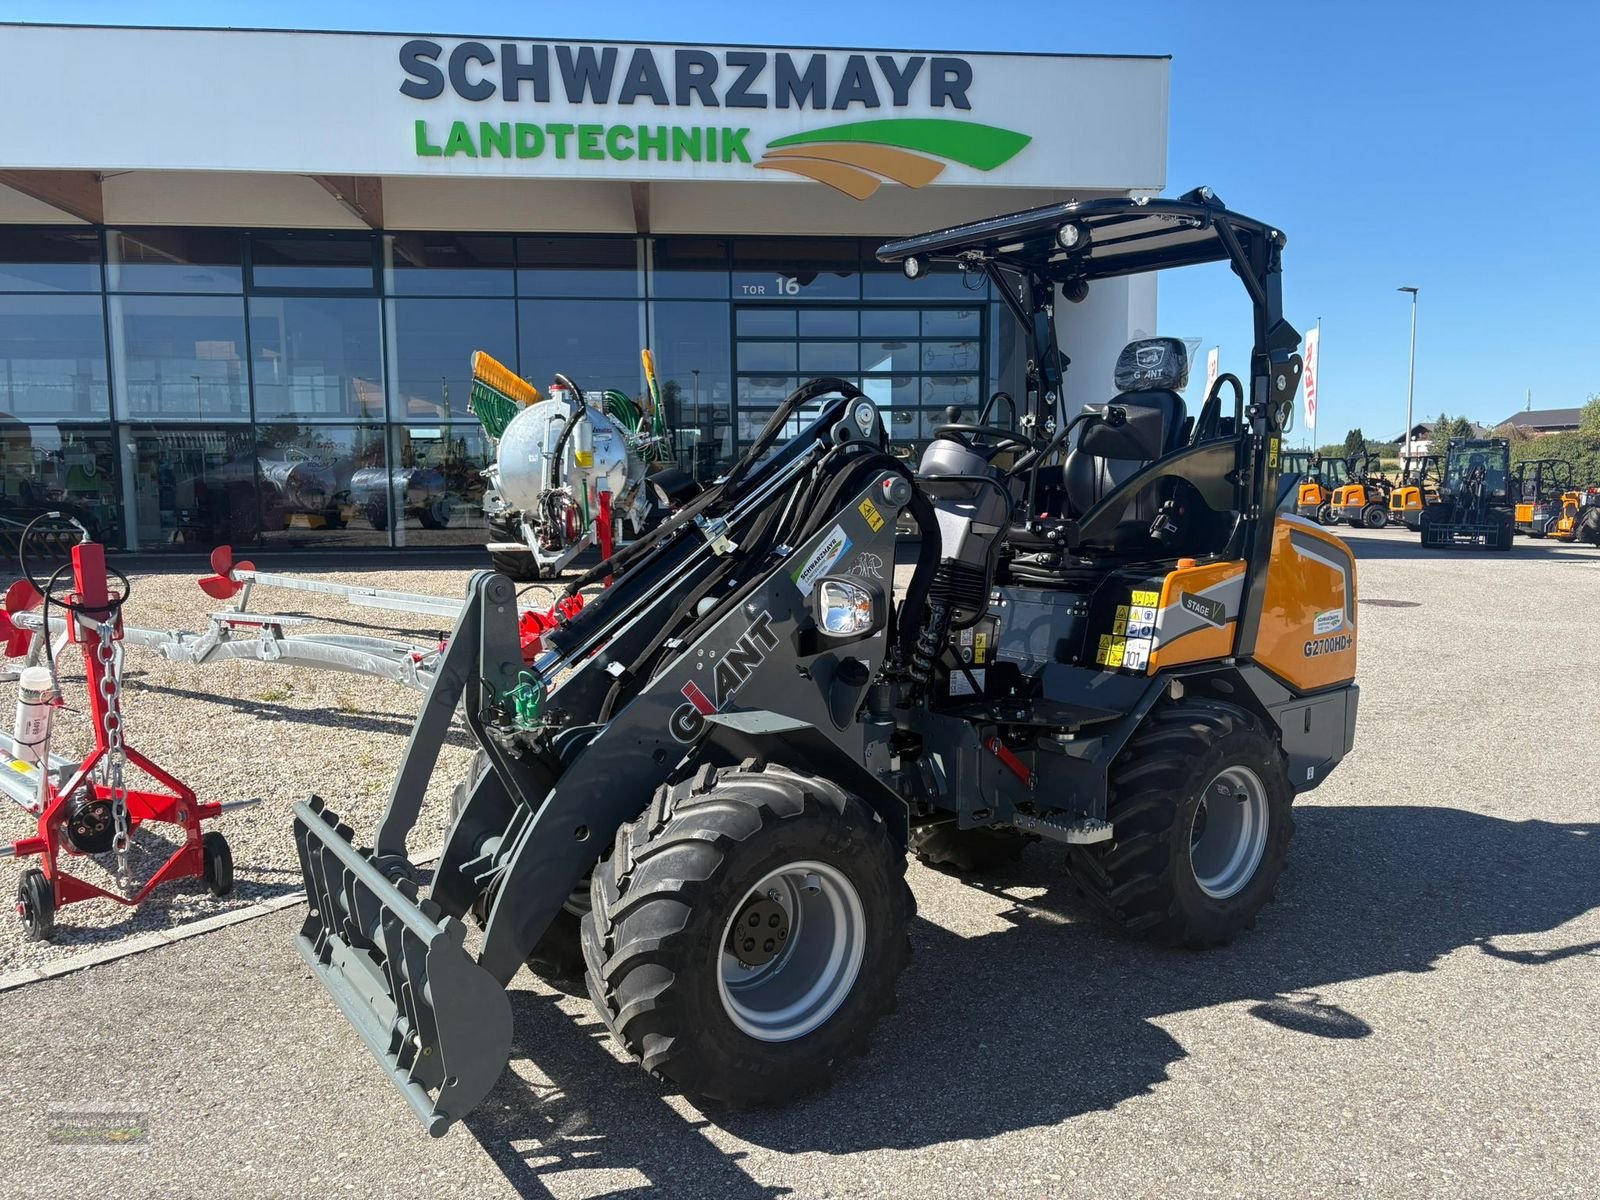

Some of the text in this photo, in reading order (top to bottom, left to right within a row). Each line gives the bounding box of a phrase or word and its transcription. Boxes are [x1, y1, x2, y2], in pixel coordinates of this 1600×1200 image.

[399, 40, 973, 111] SCHWARZMAYR
[414, 119, 752, 163] LANDTECHNIK
[741, 277, 800, 295] TOR 16
[800, 538, 837, 581] SCHWARZMAYR
[1186, 599, 1225, 619] STAGE V
[1123, 651, 1140, 667] 101
[1304, 634, 1353, 657] G2700HD+
[669, 610, 779, 743] GIANT
